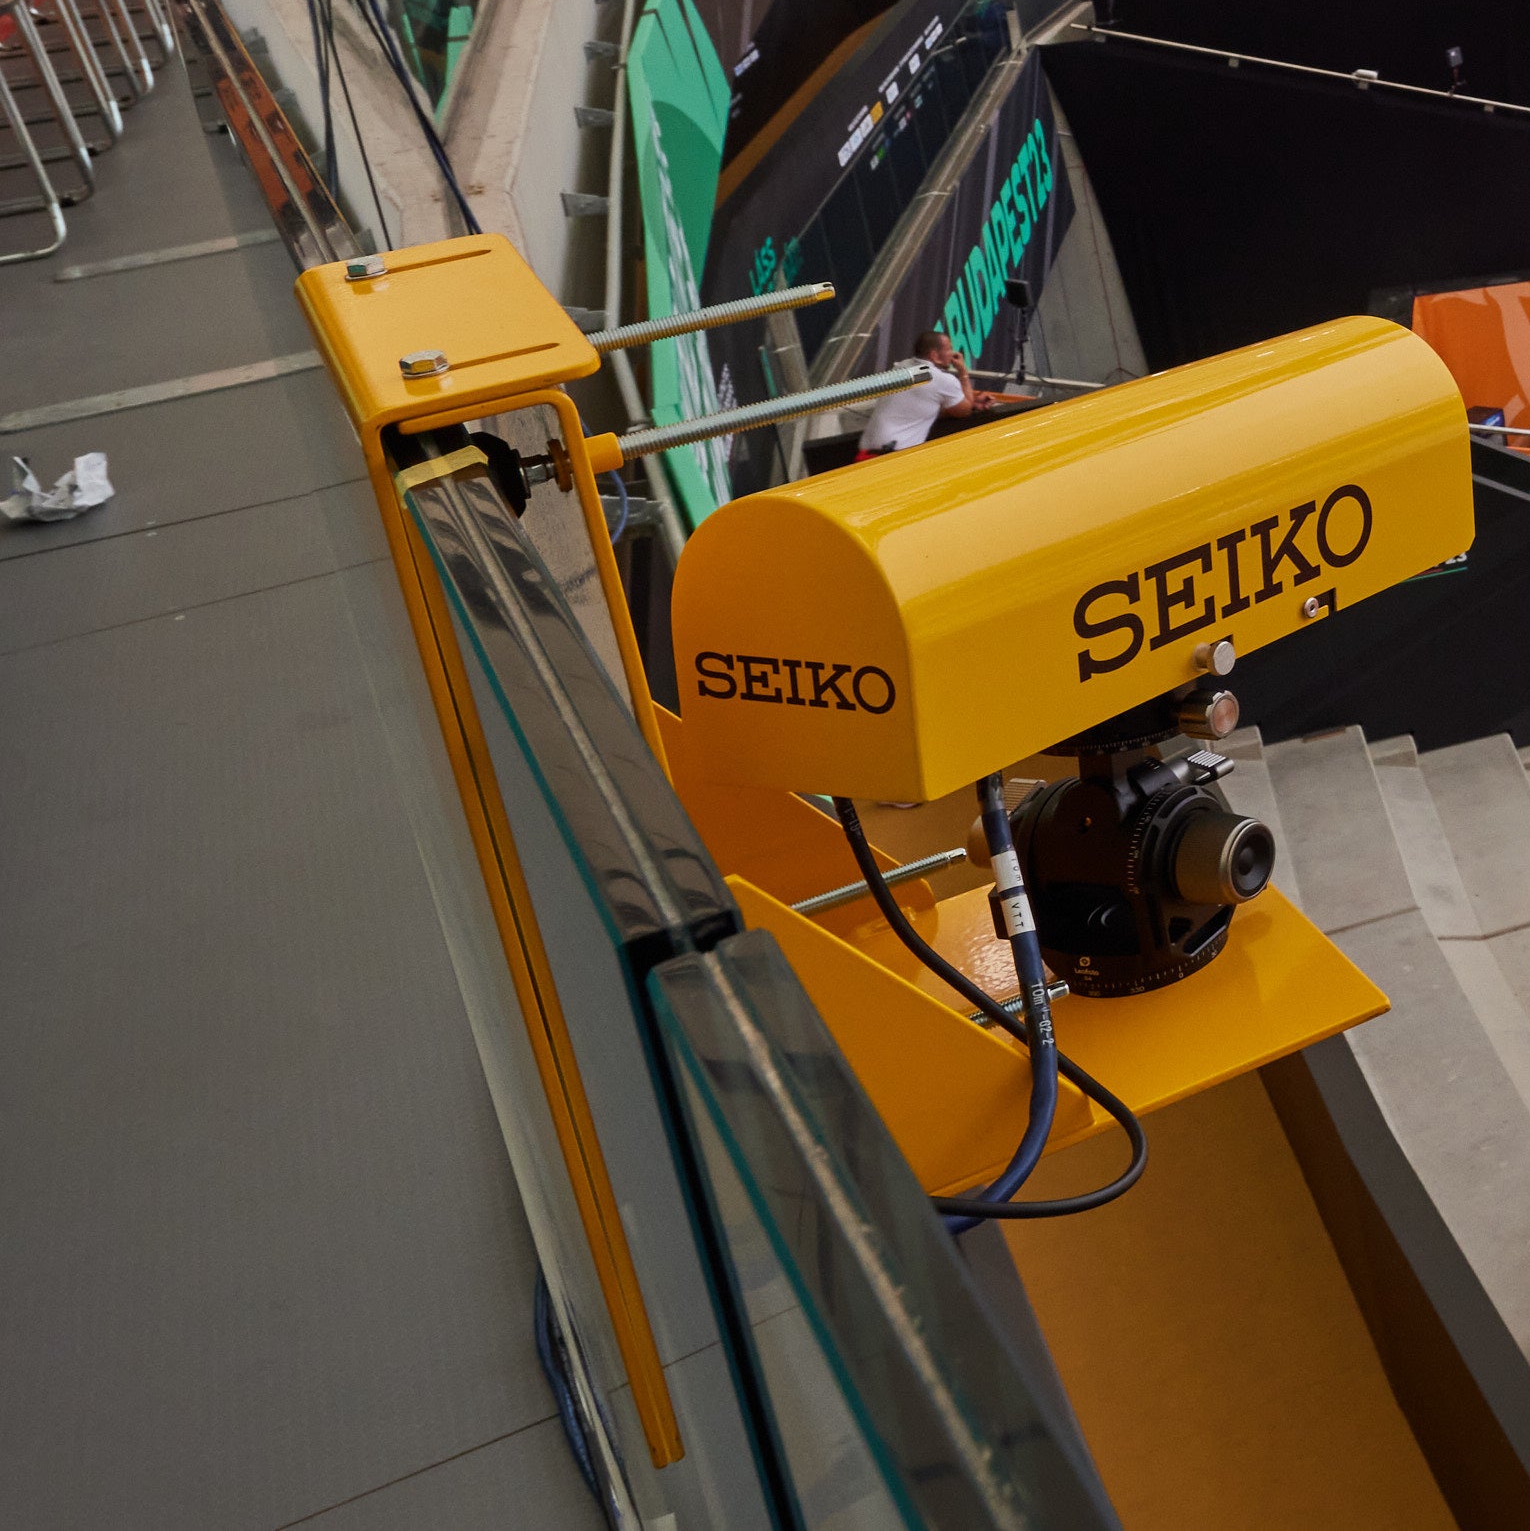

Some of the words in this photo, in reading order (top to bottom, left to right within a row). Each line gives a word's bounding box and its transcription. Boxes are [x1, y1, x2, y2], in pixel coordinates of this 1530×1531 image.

[934, 119, 1052, 370] BUDAPEST23
[695, 652, 896, 715] SEIKO
[1072, 483, 1374, 684] SEIKO
